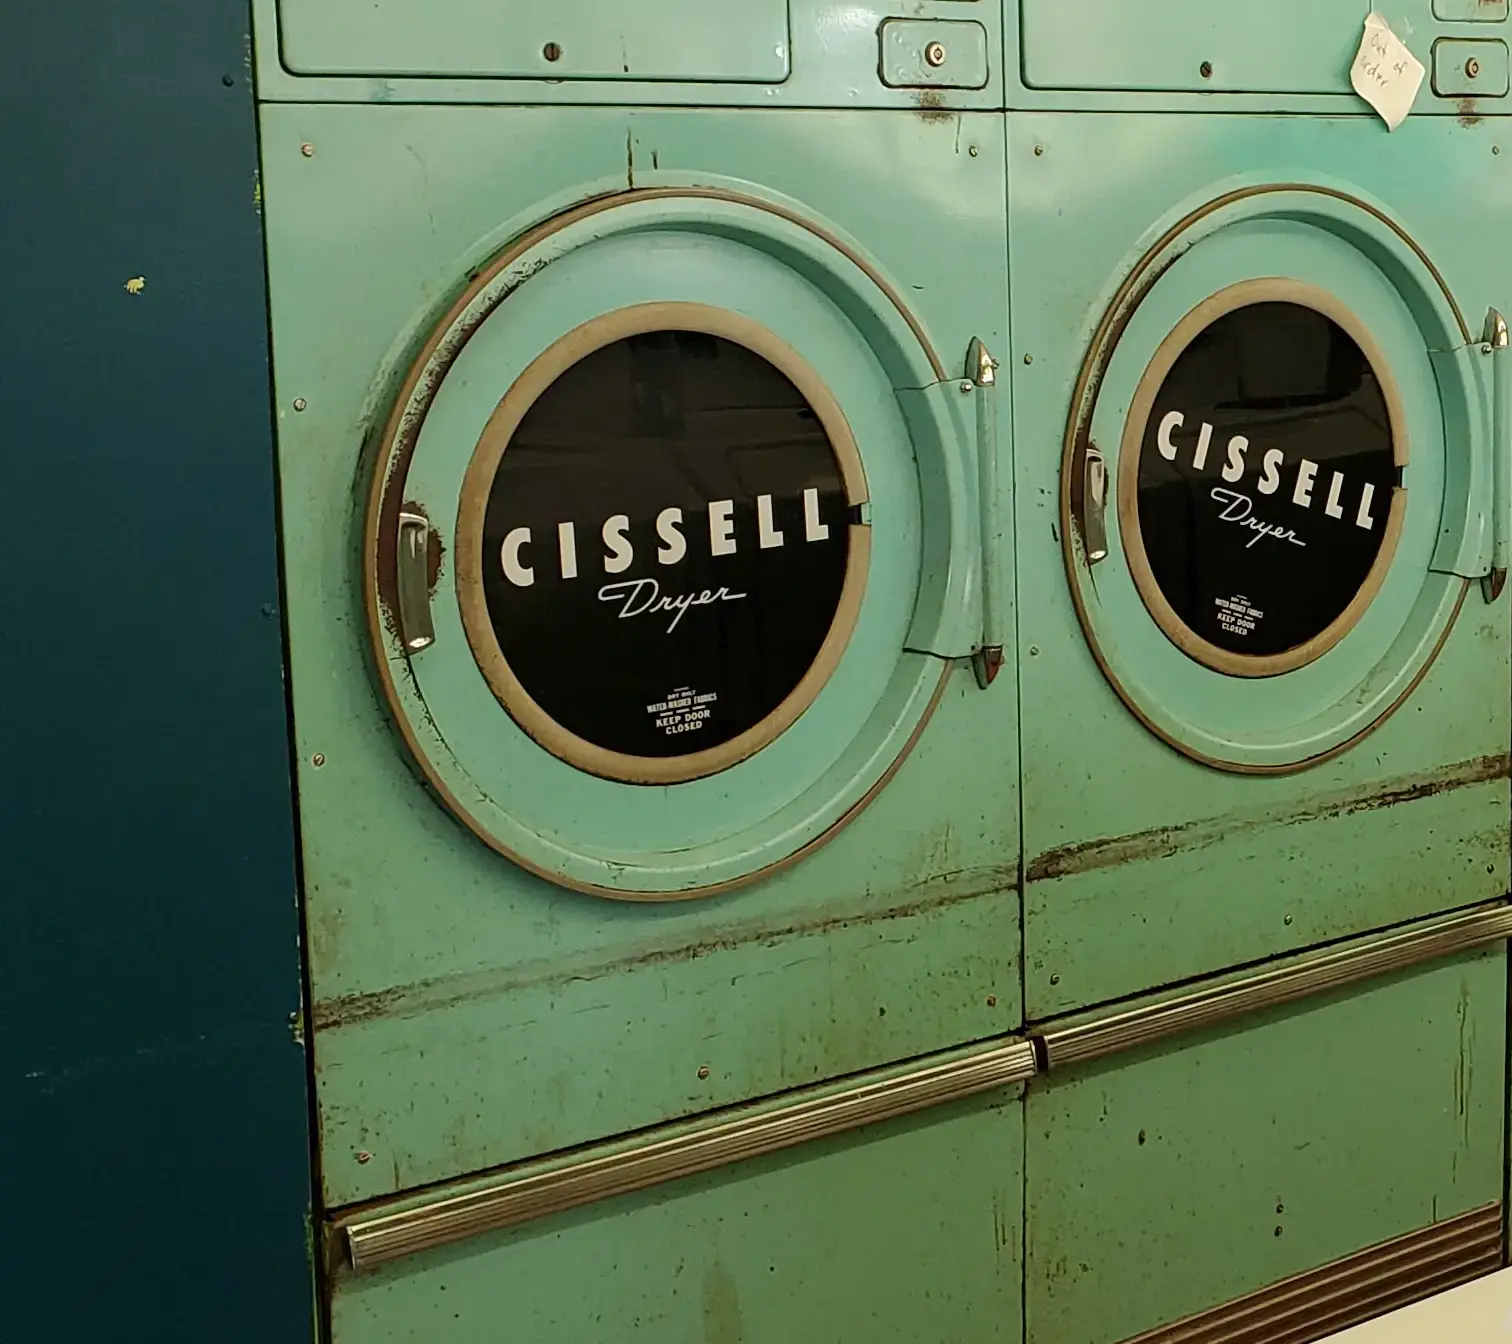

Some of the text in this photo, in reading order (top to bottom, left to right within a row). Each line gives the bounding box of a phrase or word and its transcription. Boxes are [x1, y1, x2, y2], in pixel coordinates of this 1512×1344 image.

[1157, 410, 1375, 530] CISSELL
[1210, 487, 1306, 548] Dryer
[501, 488, 829, 587] CISSELL
[598, 578, 747, 634] Dryer
[1237, 618, 1255, 630] DOOR
[1222, 622, 1247, 635] CLOSED
[656, 709, 711, 728] KEEP DOOR
[666, 720, 702, 734] CLOSED
